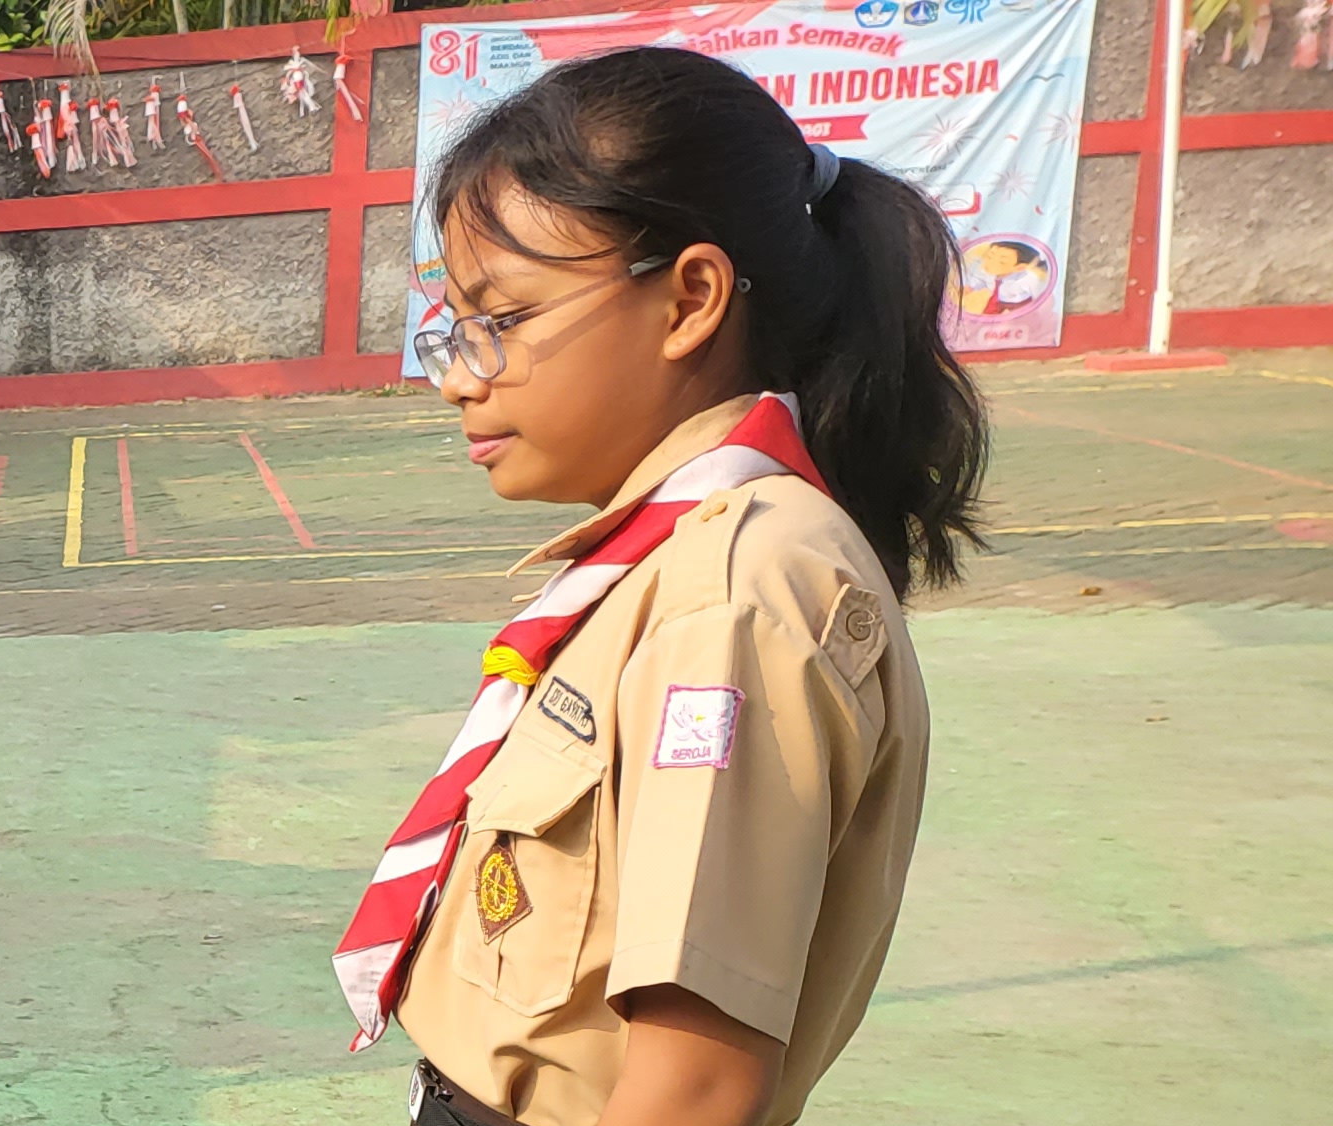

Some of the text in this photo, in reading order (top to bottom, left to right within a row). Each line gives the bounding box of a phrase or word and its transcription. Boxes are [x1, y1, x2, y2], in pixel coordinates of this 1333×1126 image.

[786, 24, 904, 56] Semarak
[809, 59, 1000, 106] INDONESIA
[671, 746, 711, 760] SEROJA
